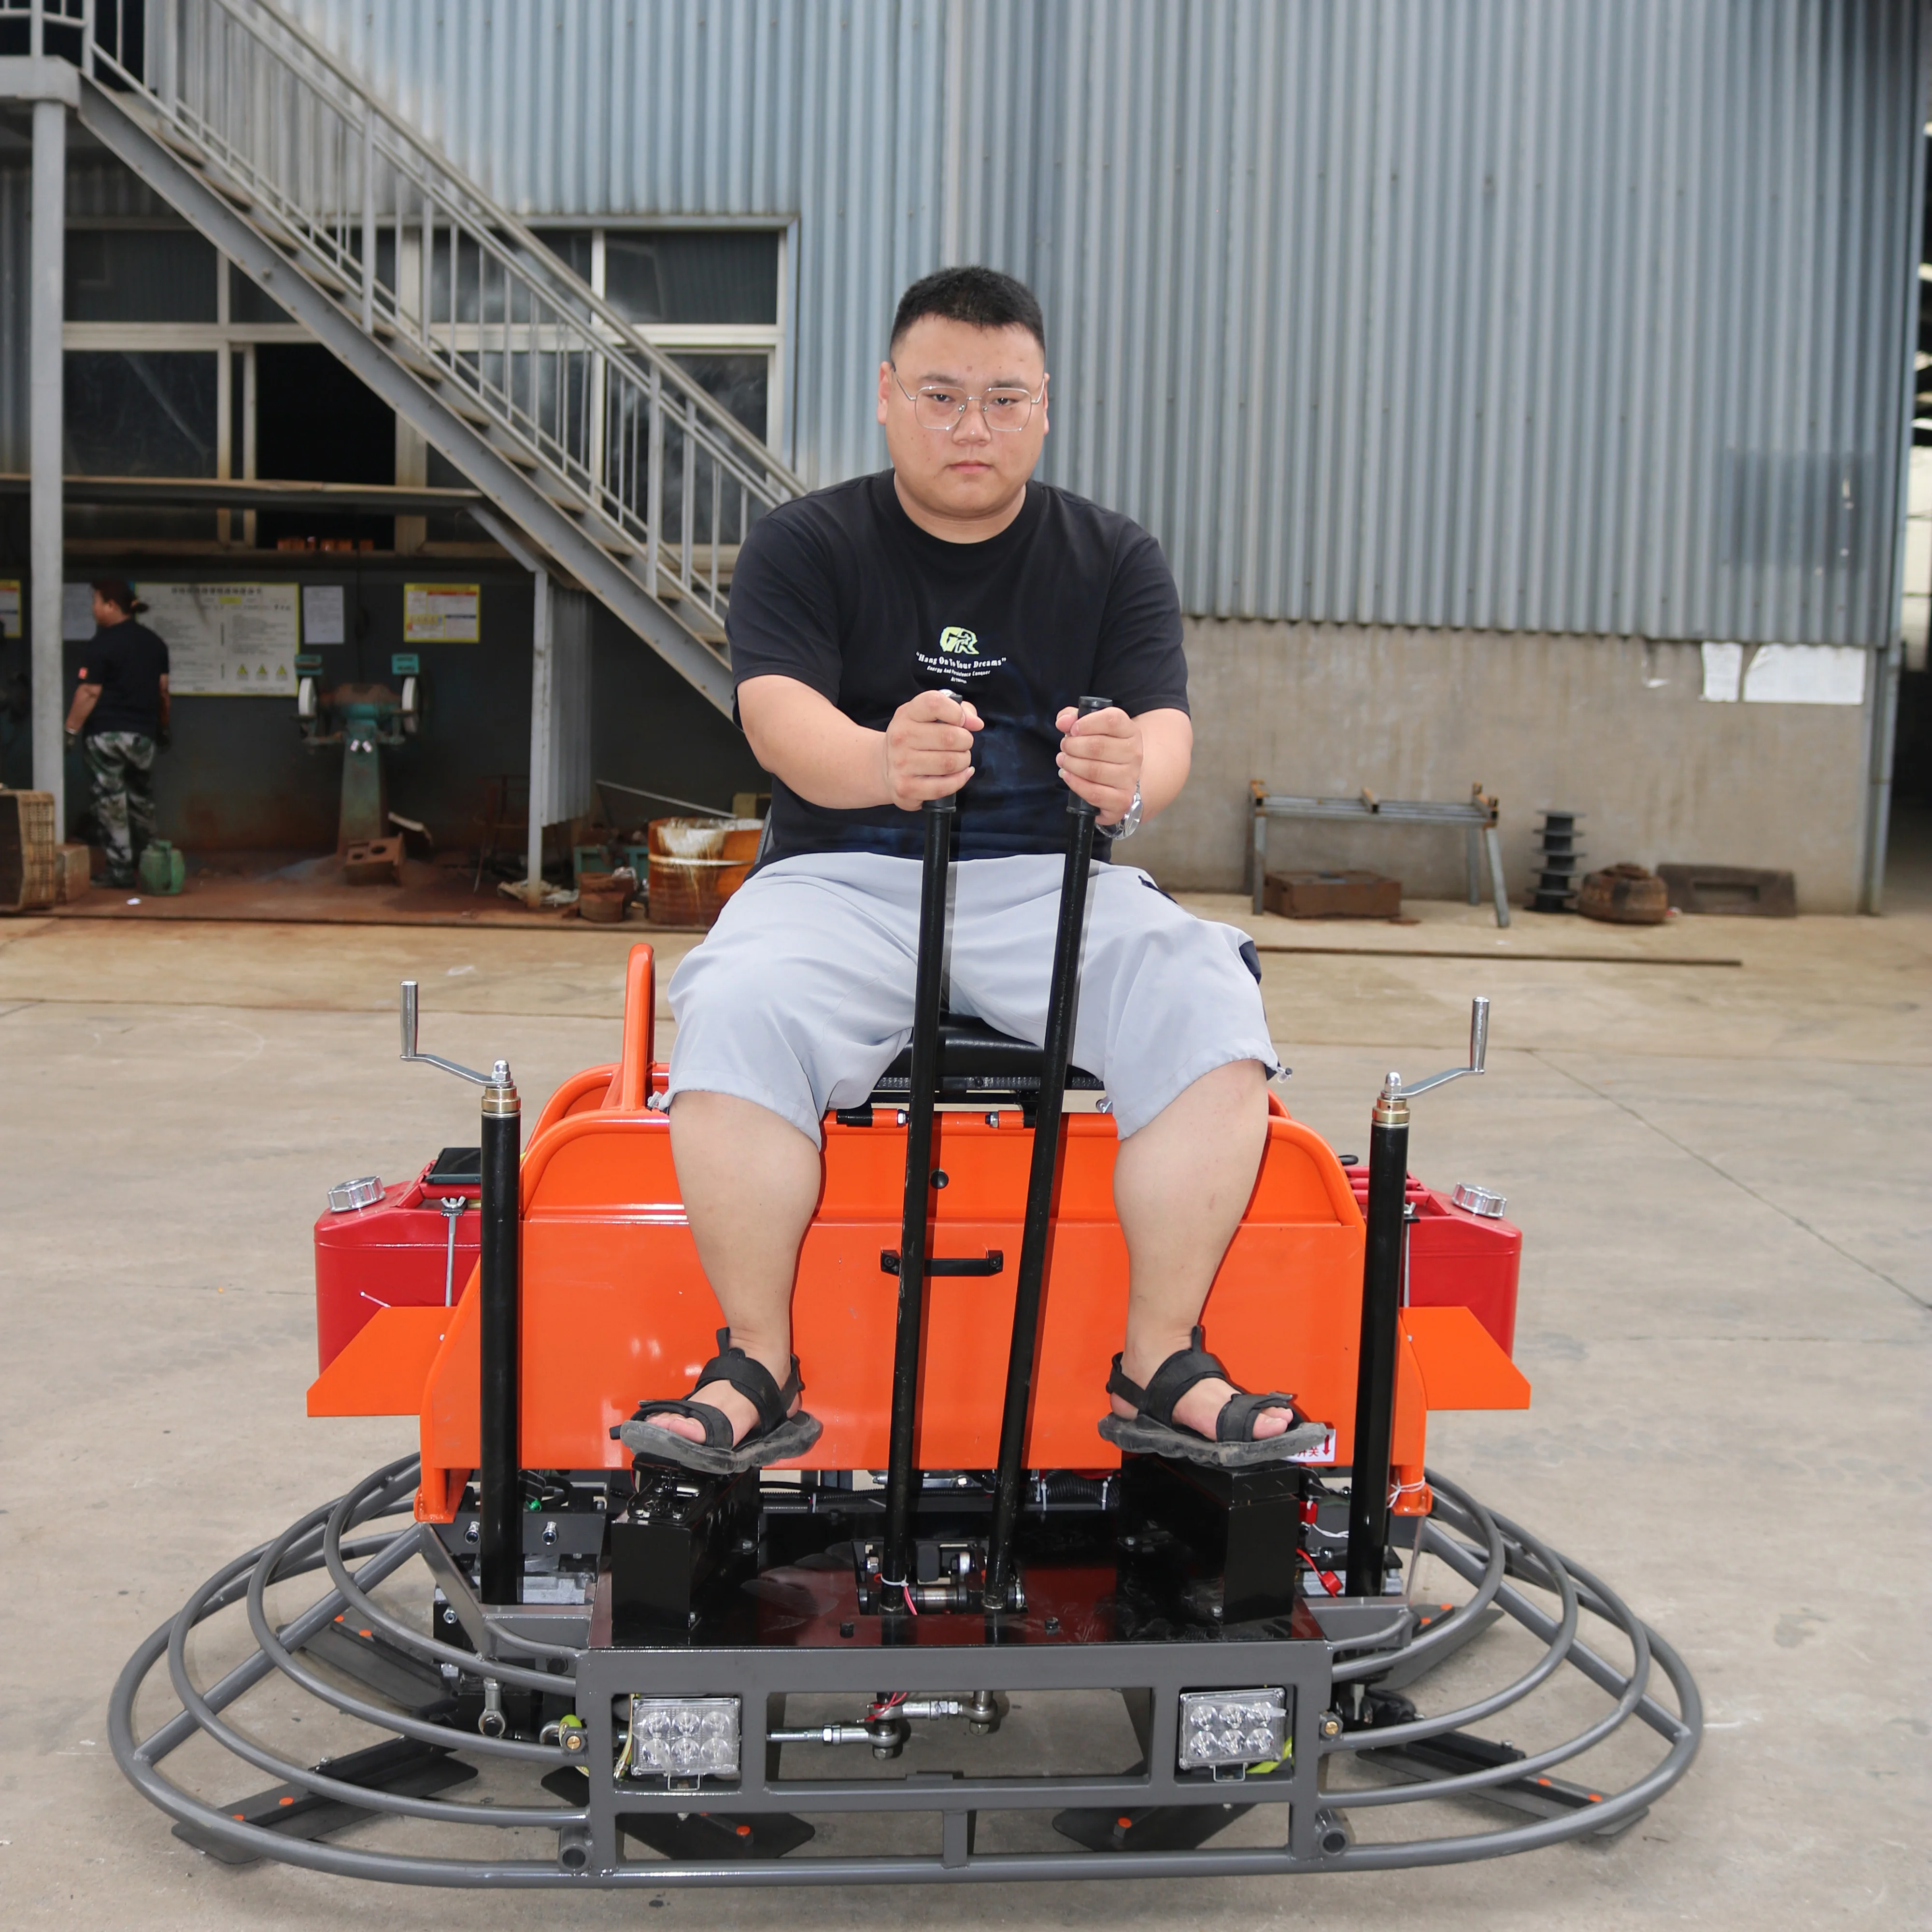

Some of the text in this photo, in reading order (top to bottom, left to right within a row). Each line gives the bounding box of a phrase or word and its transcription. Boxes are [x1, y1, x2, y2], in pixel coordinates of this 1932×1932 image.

[939, 656, 949, 665] On
[949, 658, 956, 667] To
[956, 660, 972, 669] Your
